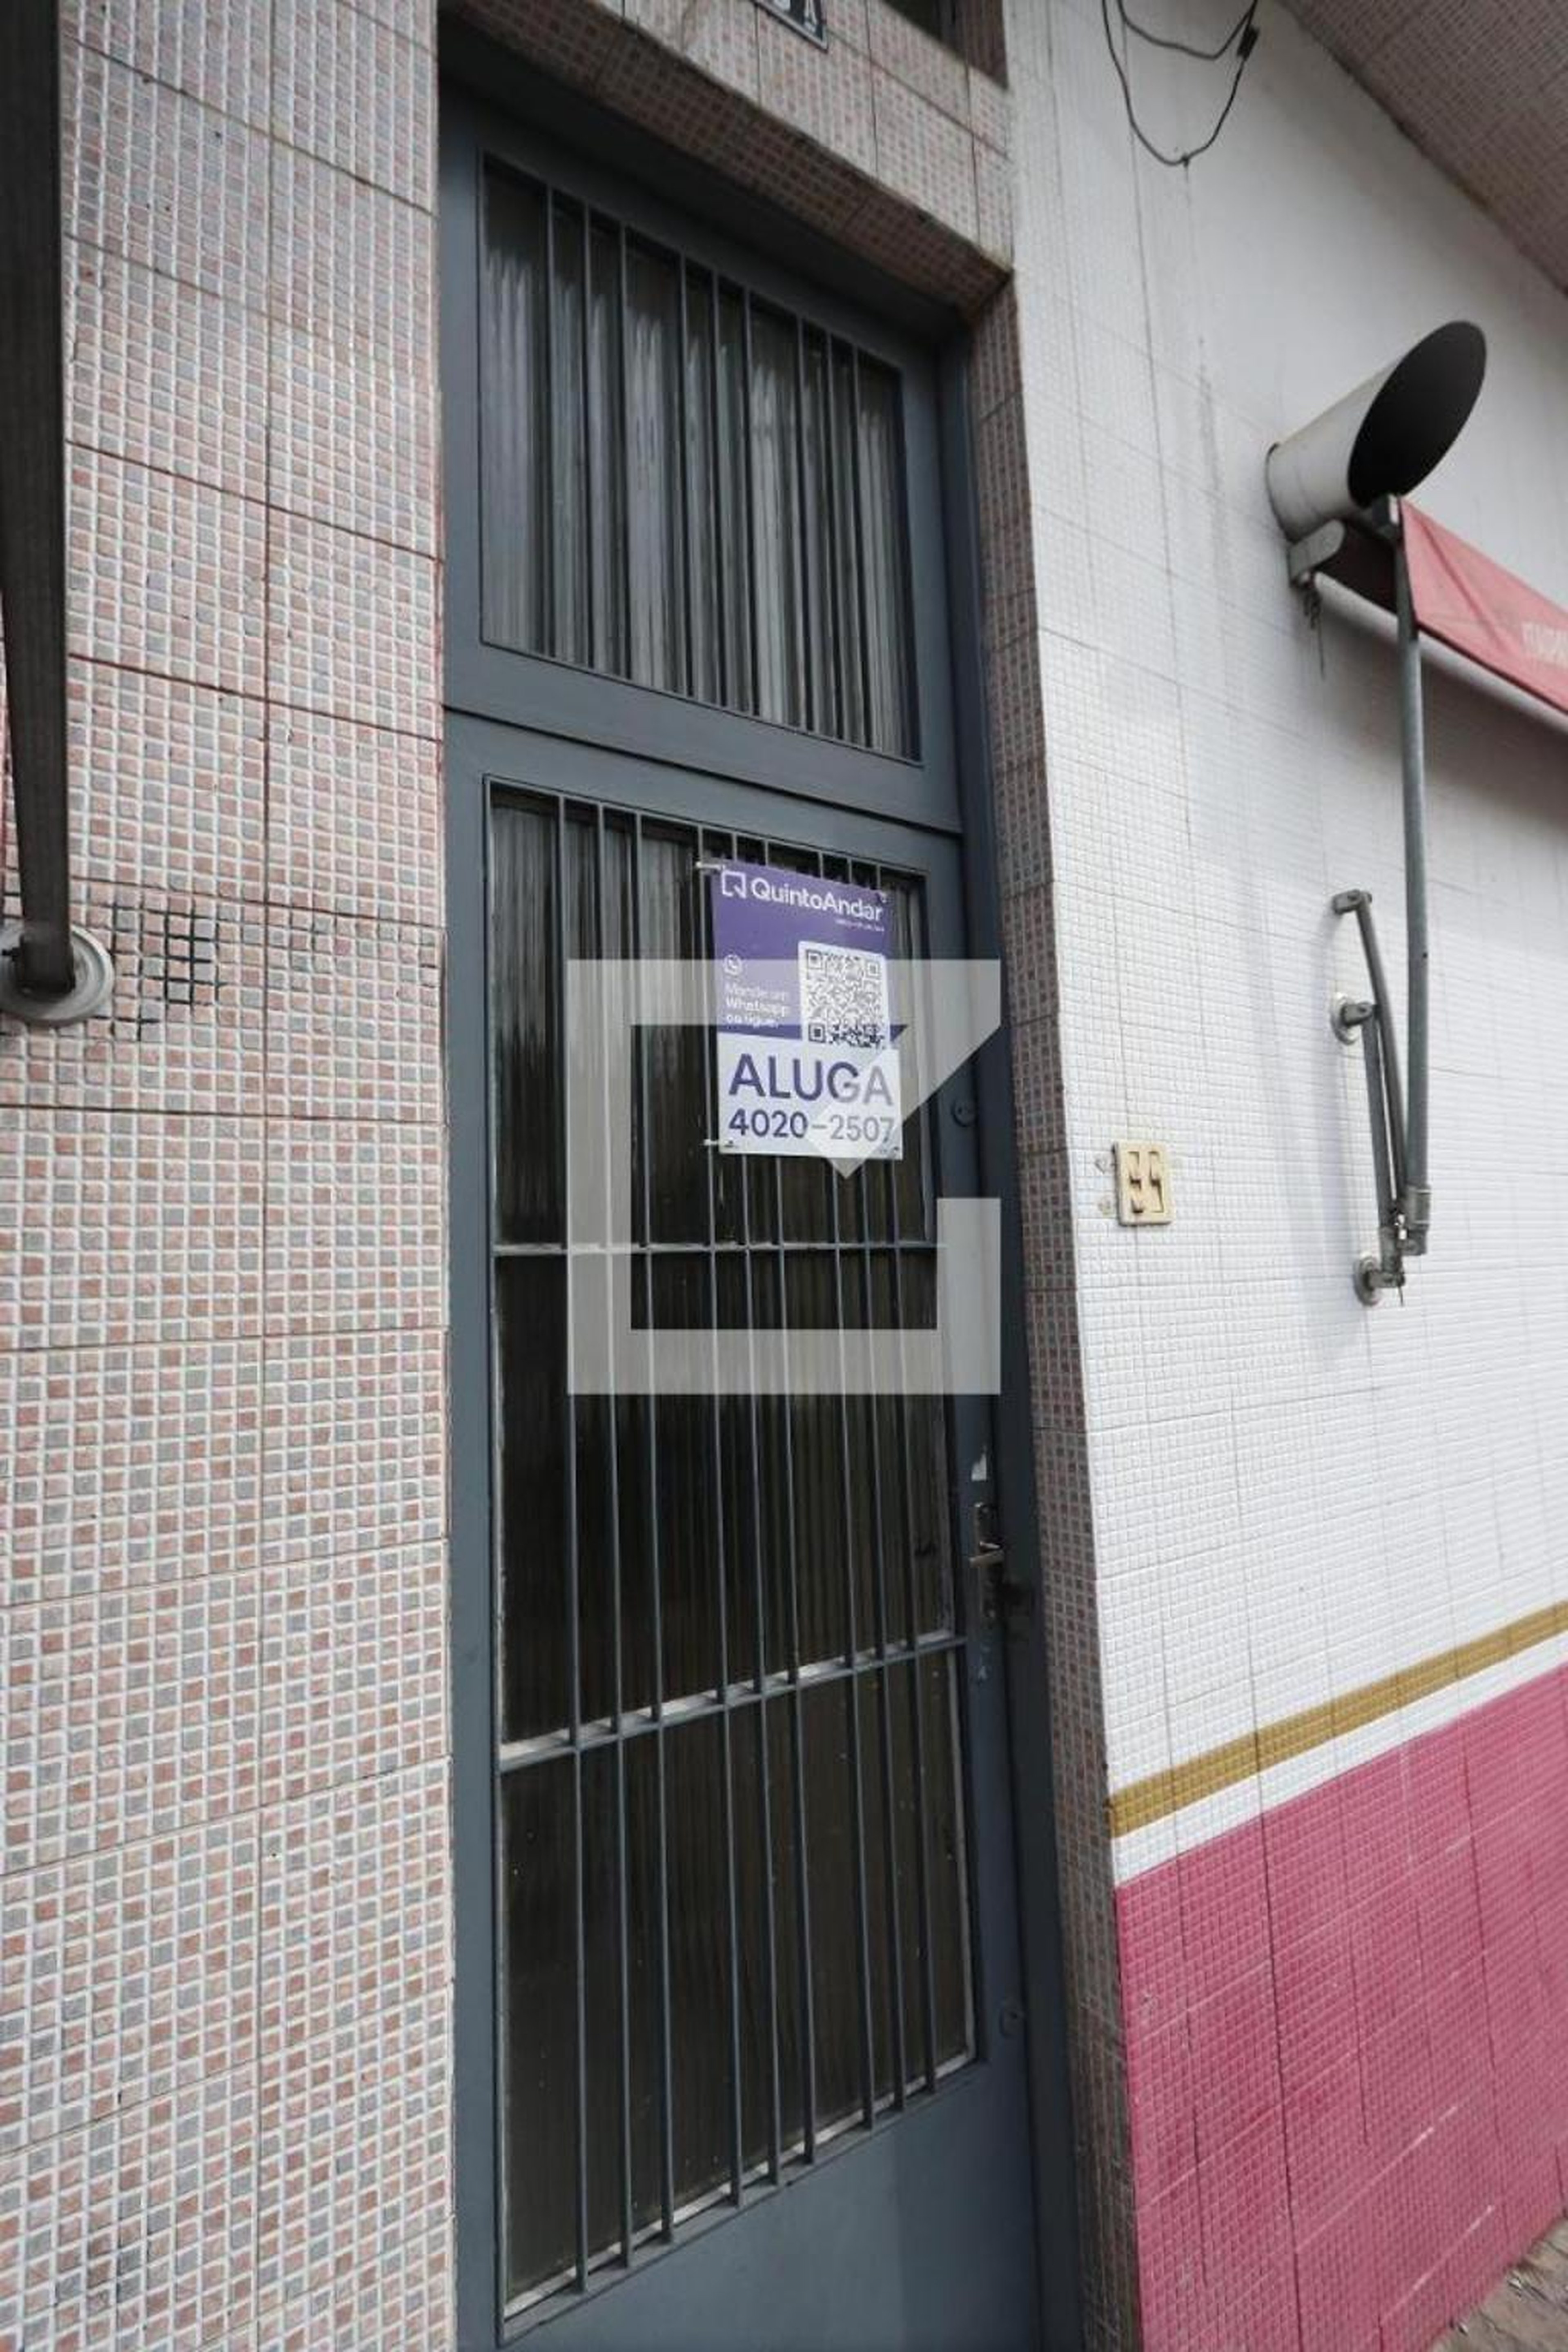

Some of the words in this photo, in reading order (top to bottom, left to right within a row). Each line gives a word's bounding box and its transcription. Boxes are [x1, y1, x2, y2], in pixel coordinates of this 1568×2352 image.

[751, 877, 883, 922] QuintoAndar
[728, 1053, 893, 1106] ALUGA
[728, 1108, 895, 1143] 4020-2507
